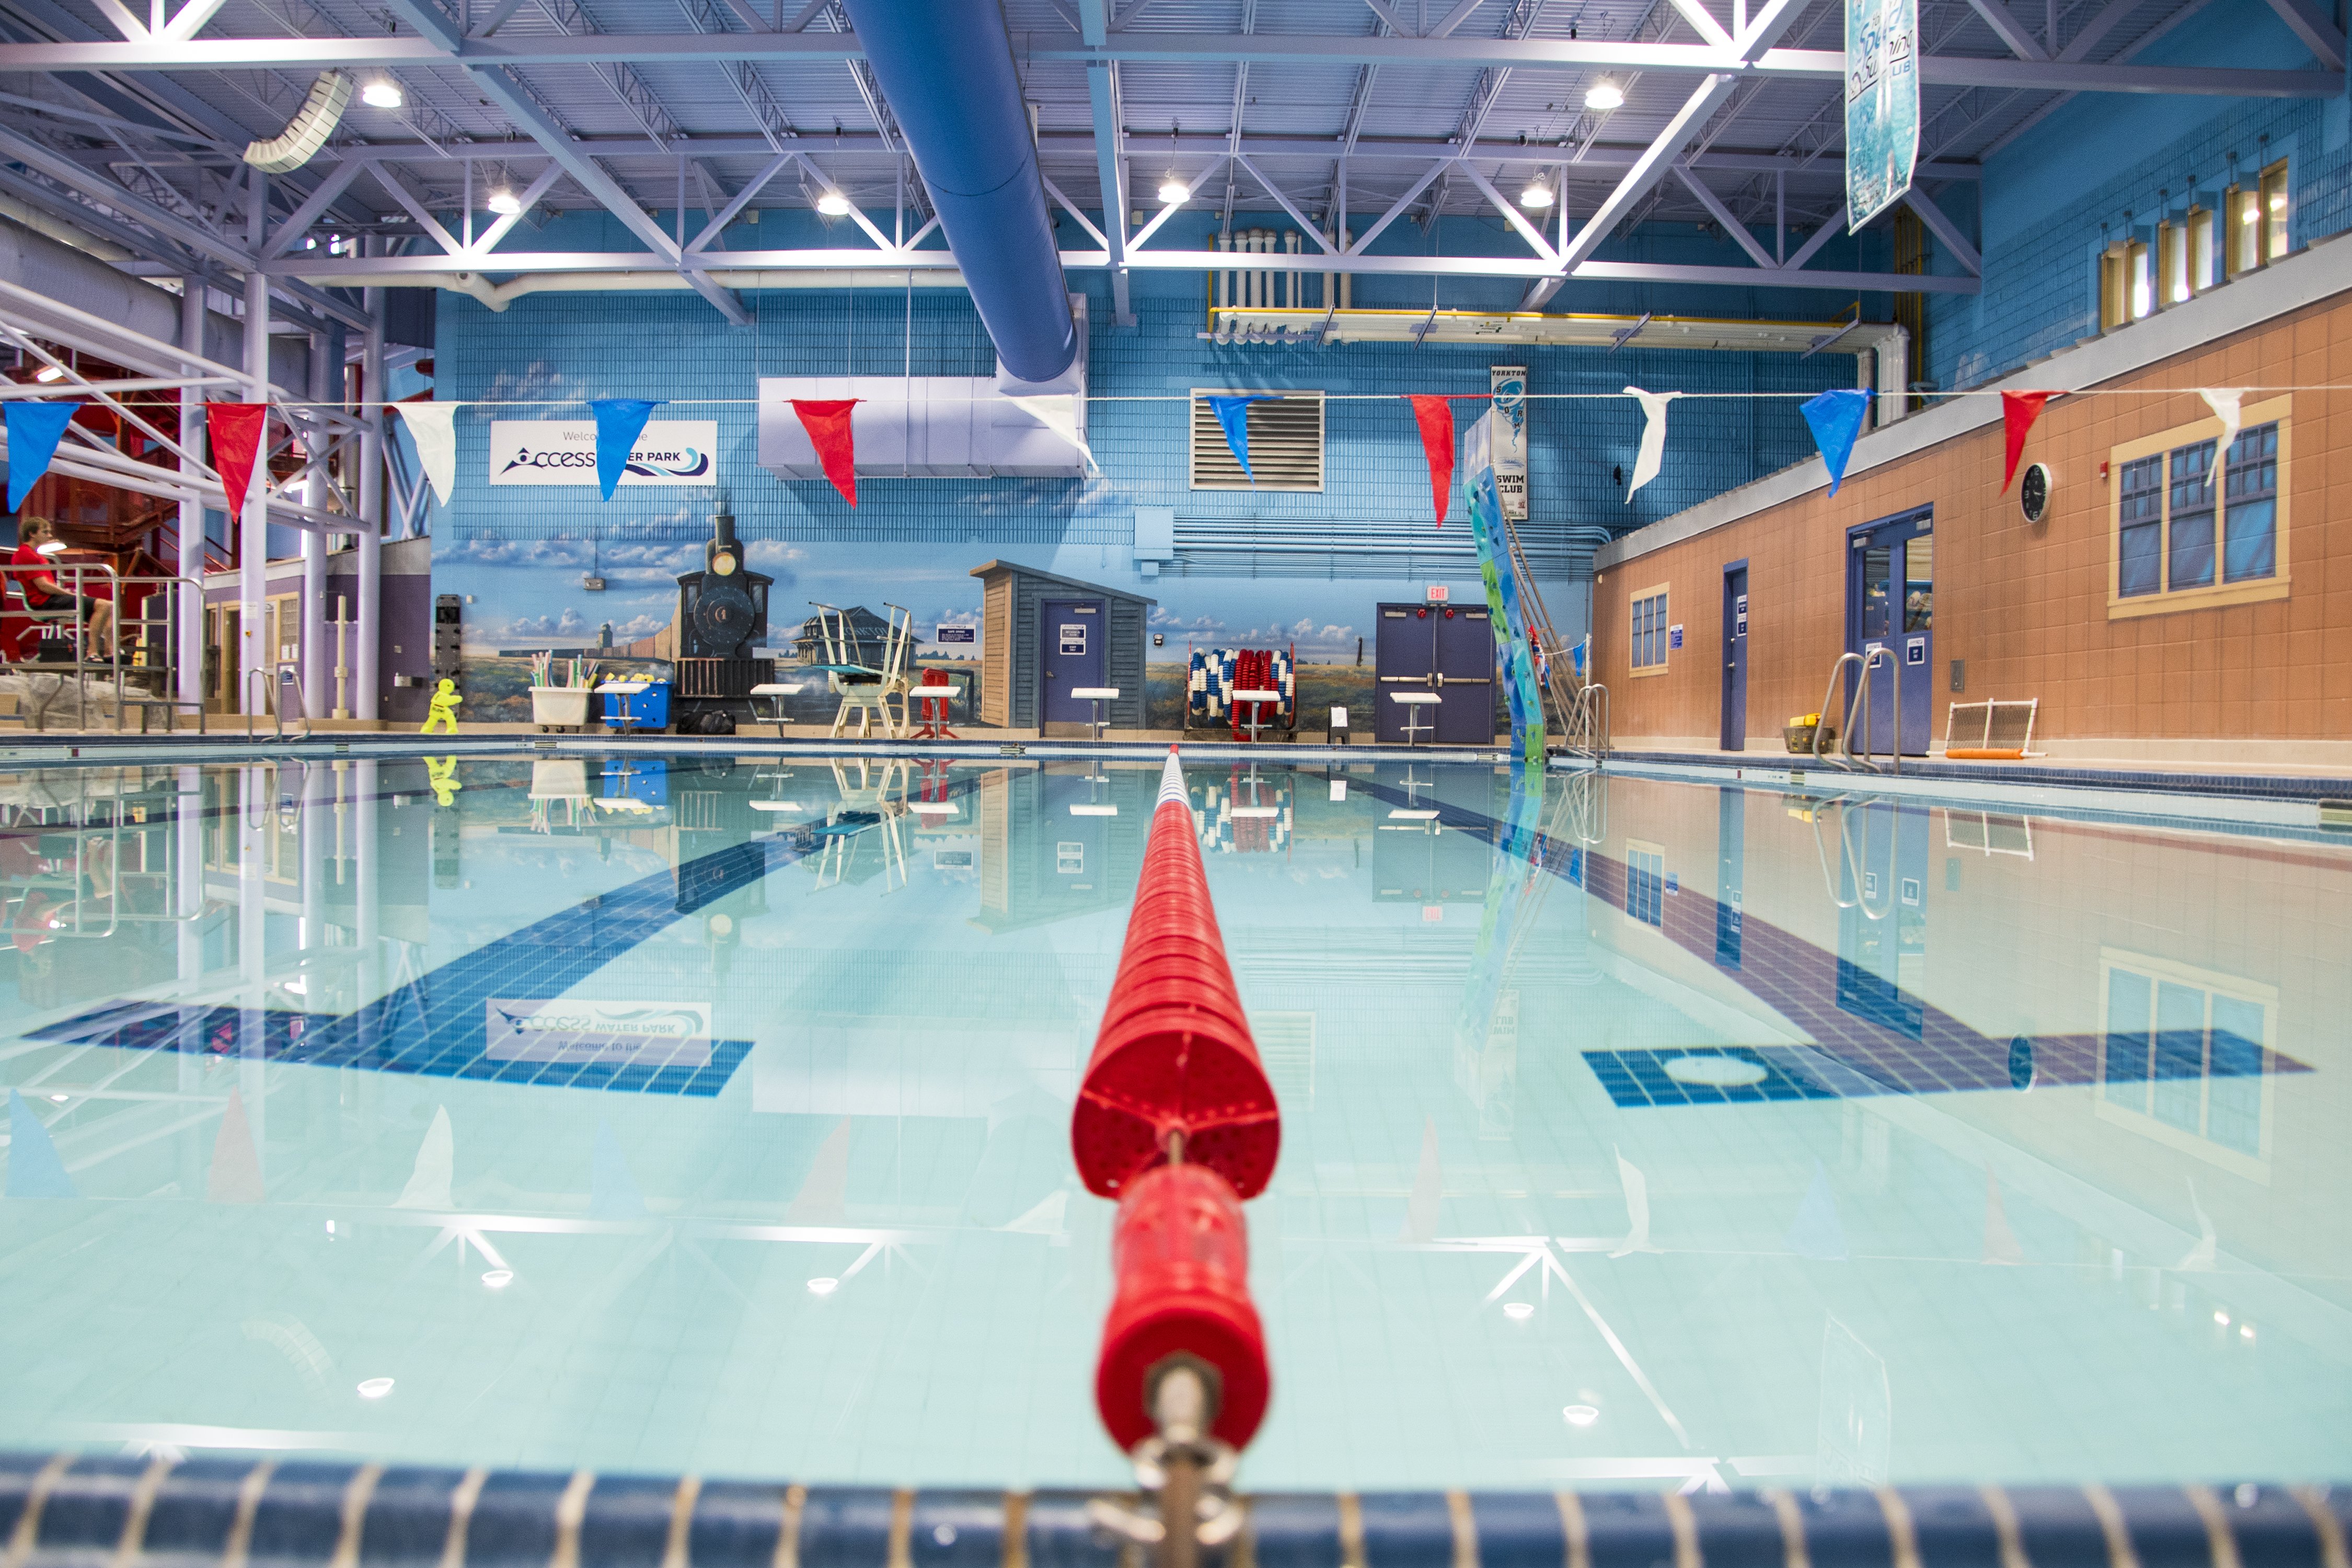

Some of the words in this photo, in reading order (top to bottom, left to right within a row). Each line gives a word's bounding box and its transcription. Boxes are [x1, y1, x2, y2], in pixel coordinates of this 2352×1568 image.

[563, 432, 597, 441] Welco
[648, 452, 681, 461] PARK
[1496, 475, 1525, 483] SWIM
[1431, 587, 1445, 598] EXIT
